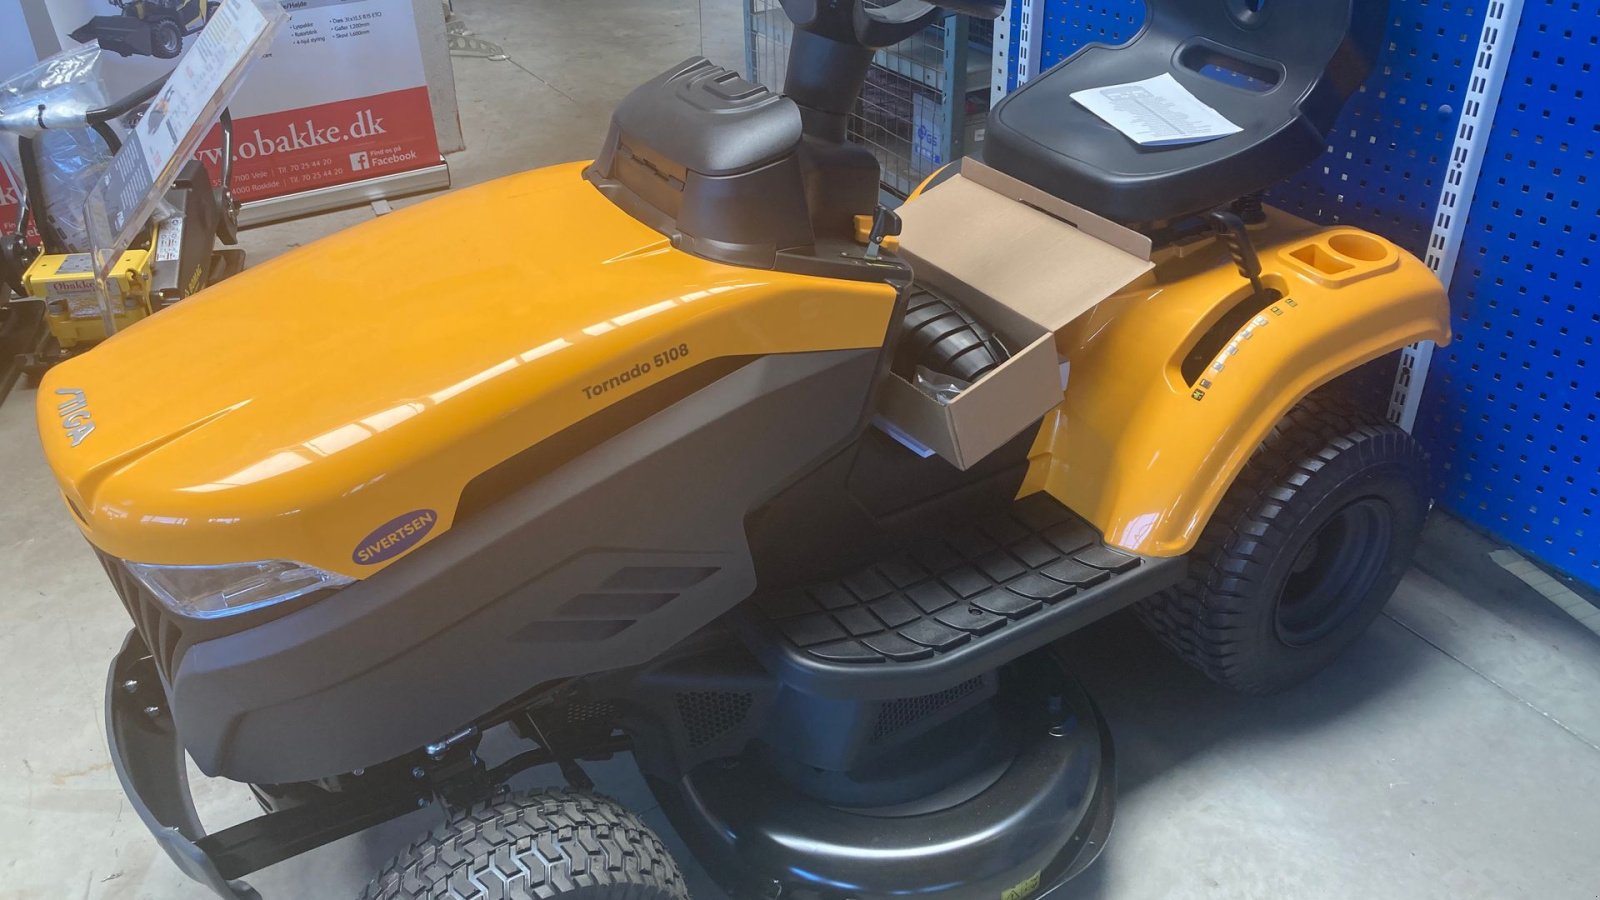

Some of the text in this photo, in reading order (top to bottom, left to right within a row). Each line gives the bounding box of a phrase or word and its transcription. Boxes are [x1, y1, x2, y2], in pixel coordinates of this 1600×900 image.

[322, 158, 332, 166] 20
[371, 150, 417, 167] Facebook
[234, 174, 250, 182] 7100
[251, 171, 268, 179] Vejle
[333, 167, 343, 176] 20
[582, 343, 689, 400] Tornado 5108
[357, 512, 433, 562] SIVERTSEN
